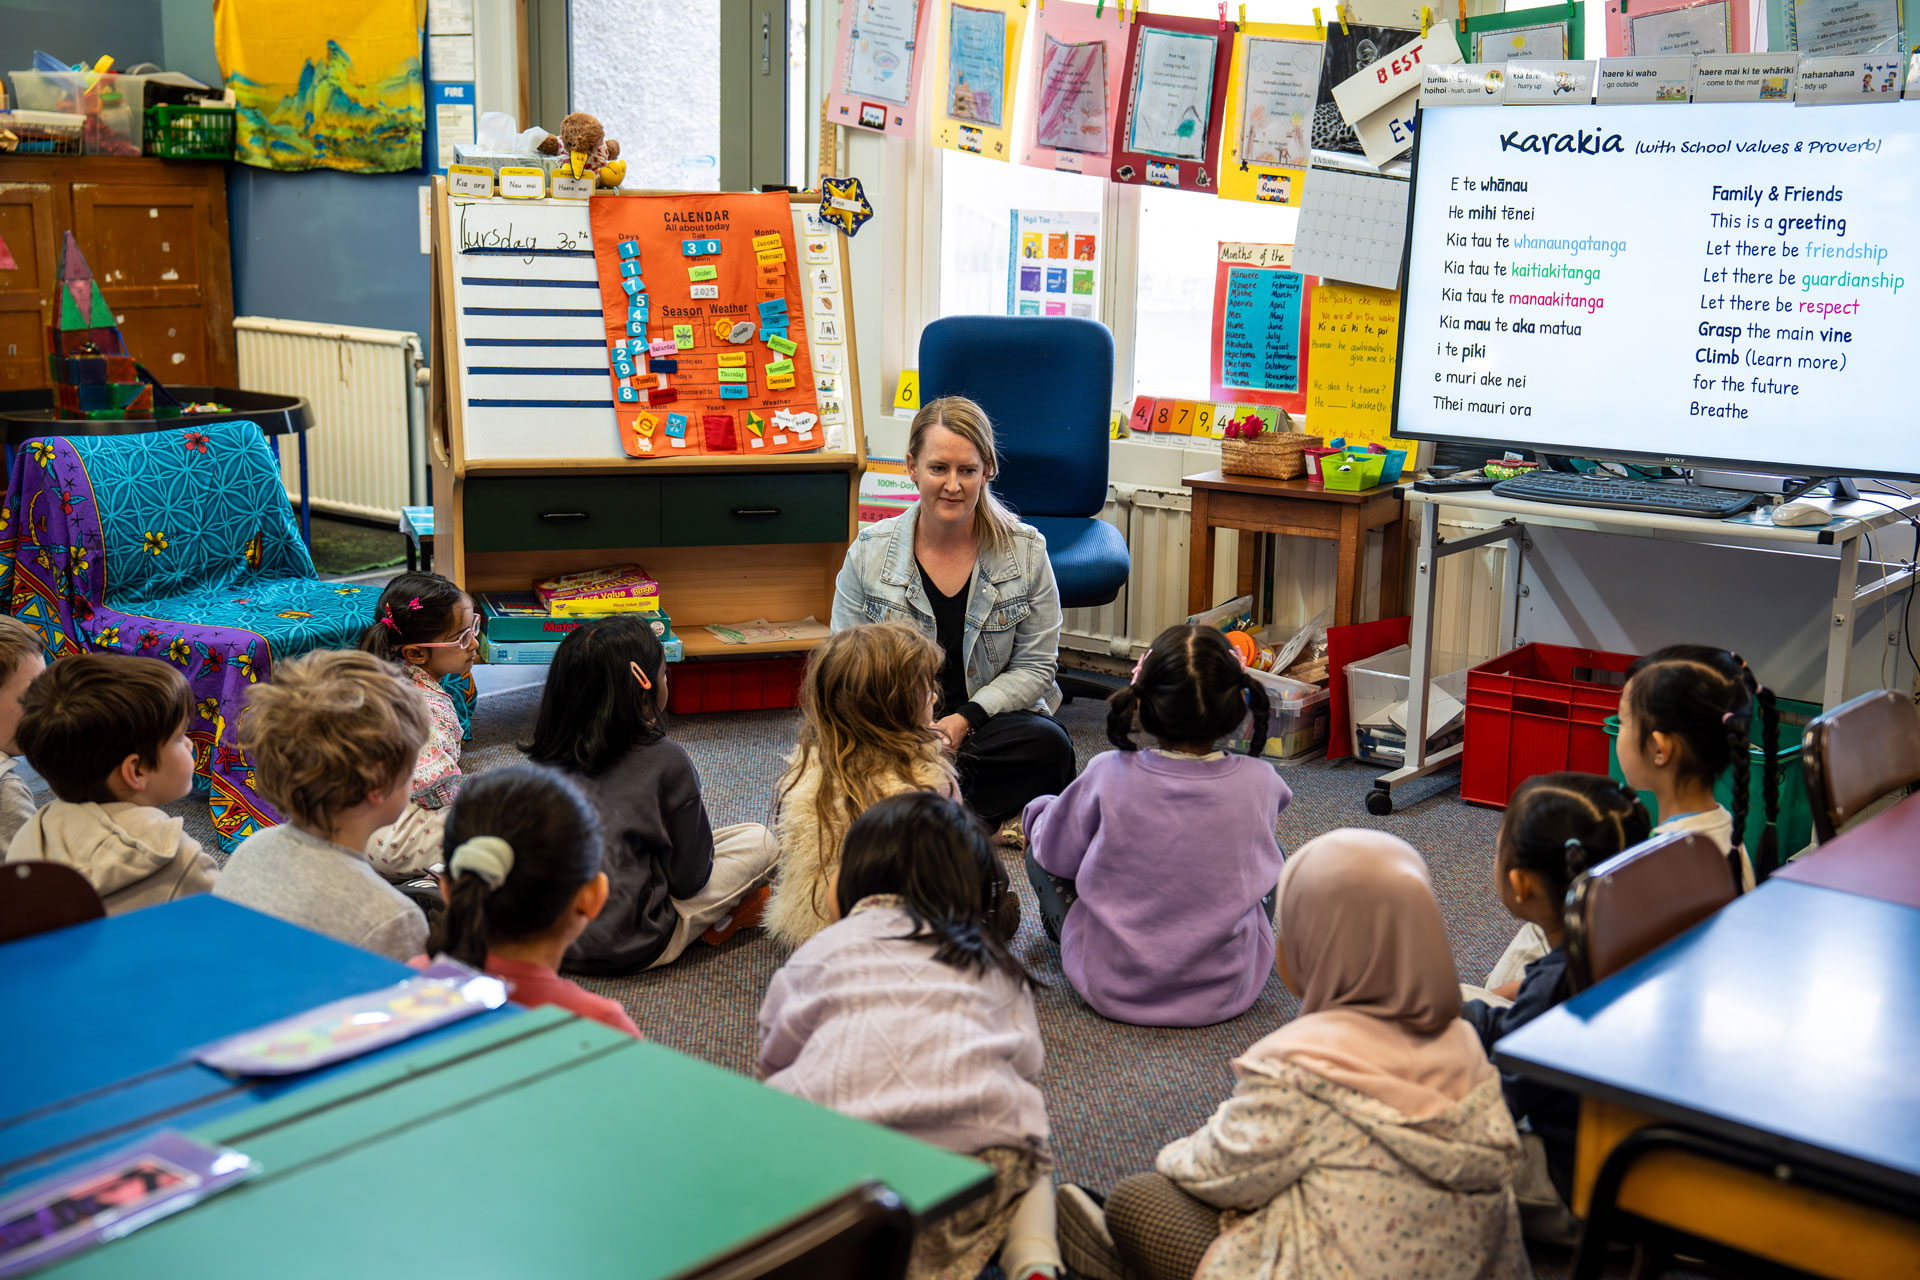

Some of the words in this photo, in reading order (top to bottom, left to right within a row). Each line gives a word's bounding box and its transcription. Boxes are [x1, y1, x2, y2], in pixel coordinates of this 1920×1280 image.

[1376, 45, 1423, 84] BEST
[1602, 70, 1627, 78] haere
[1629, 70, 1634, 78] ki
[1635, 69, 1657, 77] waho
[1699, 67, 1723, 76] haere
[1725, 67, 1740, 75] mai
[1742, 67, 1751, 75] ki
[1752, 67, 1761, 75] te
[1762, 67, 1794, 75] whāriki
[1802, 70, 1855, 79] nahanahana
[1616, 80, 1639, 88] outside
[1746, 78, 1760, 86] mat
[1803, 83, 1817, 91] tidy
[444, 87, 464, 98] FIRE
[1424, 86, 1447, 95] hoihoi
[1500, 127, 1625, 156] Karakia
[1635, 140, 1676, 155] (with
[1680, 140, 1732, 154] School
[1736, 139, 1790, 154] Values
[1793, 141, 1803, 152] &
[1808, 138, 1882, 154] Proverb)
[1151, 171, 1169, 180] Leah
[456, 178, 468, 188] Kia
[1261, 183, 1284, 195] Rowan
[1451, 177, 1459, 191] E
[1463, 176, 1476, 191] te
[1480, 176, 1528, 193] whānau
[1712, 184, 1763, 208] Family
[1768, 185, 1779, 201] &
[1784, 185, 1843, 202] Friends
[664, 210, 730, 223] CALENDAR
[1449, 205, 1464, 219] He
[1468, 204, 1497, 220] mihi
[1501, 205, 1535, 221] tēnei
[665, 224, 678, 232] All
[680, 223, 704, 232] about
[705, 222, 730, 232] today
[1710, 212, 1741, 228] This
[1747, 214, 1759, 229] is
[1764, 218, 1773, 229] a
[1777, 213, 1846, 237] greeting
[454, 202, 536, 264] Thursday
[618, 233, 640, 242] Days
[625, 243, 633, 255] 1
[1446, 232, 1467, 247] Kia
[1471, 232, 1492, 248] tau
[1496, 233, 1510, 248] te
[1514, 233, 1626, 257] whanaungatanga
[1221, 248, 1252, 260] Months
[1259, 248, 1267, 265] of
[1271, 249, 1284, 262] the
[1706, 240, 1731, 256] Let
[1735, 240, 1776, 257] there
[1782, 241, 1799, 257] be
[1805, 241, 1888, 266] friendship
[627, 263, 635, 274] 1
[1444, 260, 1465, 275] Kia
[1469, 260, 1490, 276] tau
[1493, 261, 1507, 276] te
[1511, 261, 1600, 286] kaitiakitanga
[1271, 273, 1299, 282] January
[1703, 267, 1728, 283] Let
[1732, 267, 1773, 284] there
[1779, 268, 1796, 285] be
[1801, 270, 1905, 295] guardianship
[626, 280, 636, 291] 7
[1271, 281, 1300, 292] February
[694, 288, 716, 296] 2025
[1271, 290, 1292, 299] March
[636, 295, 645, 306] 5
[1269, 300, 1286, 310] April
[1442, 287, 1462, 302] Kia
[1466, 288, 1487, 303] tau
[1491, 289, 1505, 304] te
[1509, 291, 1604, 314] manaakitanga
[662, 305, 703, 317] Season
[709, 303, 748, 314] Weather
[1700, 294, 1725, 310] Let
[1729, 294, 1770, 312] there
[1776, 296, 1793, 312] be
[1799, 299, 1860, 320] respect
[632, 310, 641, 320] 4
[632, 323, 641, 333] 6
[1440, 315, 1460, 329] Kia
[1464, 320, 1491, 332] mau
[1495, 317, 1508, 332] te
[1512, 318, 1536, 334] aka
[1539, 320, 1582, 336] matua
[1698, 321, 1742, 344] Grasp
[1746, 322, 1771, 339] the
[1776, 326, 1814, 341] main
[1819, 327, 1852, 343] vine
[633, 340, 645, 352] 2
[652, 343, 676, 352] Saturday
[1437, 342, 1441, 355] i
[1445, 341, 1458, 356] te
[1461, 343, 1486, 363] piki
[617, 350, 626, 360] 2
[720, 354, 744, 362] Wednesday
[1695, 347, 1740, 365] Climb
[1745, 348, 1792, 368] (learn
[1798, 352, 1846, 372] more)
[619, 363, 630, 375] 9
[768, 363, 791, 373] November
[721, 371, 744, 379] Thursday
[770, 377, 792, 385] December
[1435, 372, 1442, 382] e
[1446, 372, 1476, 385] muri
[1480, 371, 1502, 387] ake
[1507, 375, 1526, 388] nei
[1693, 373, 1717, 390] for
[1721, 375, 1745, 392] the
[1751, 377, 1799, 395] future
[623, 389, 632, 400] 8
[724, 387, 743, 395] Friday
[902, 382, 912, 401] 6
[1433, 396, 1463, 411] Tīhei
[1468, 401, 1505, 414] mauri
[1509, 405, 1532, 417] ora
[1690, 401, 1749, 419] Breathe
[1158, 407, 1168, 424] 8
[1178, 409, 1188, 424] 7
[877, 479, 915, 491] 100th-Day
[600, 589, 626, 600] Value
[632, 584, 656, 597] Bingo
